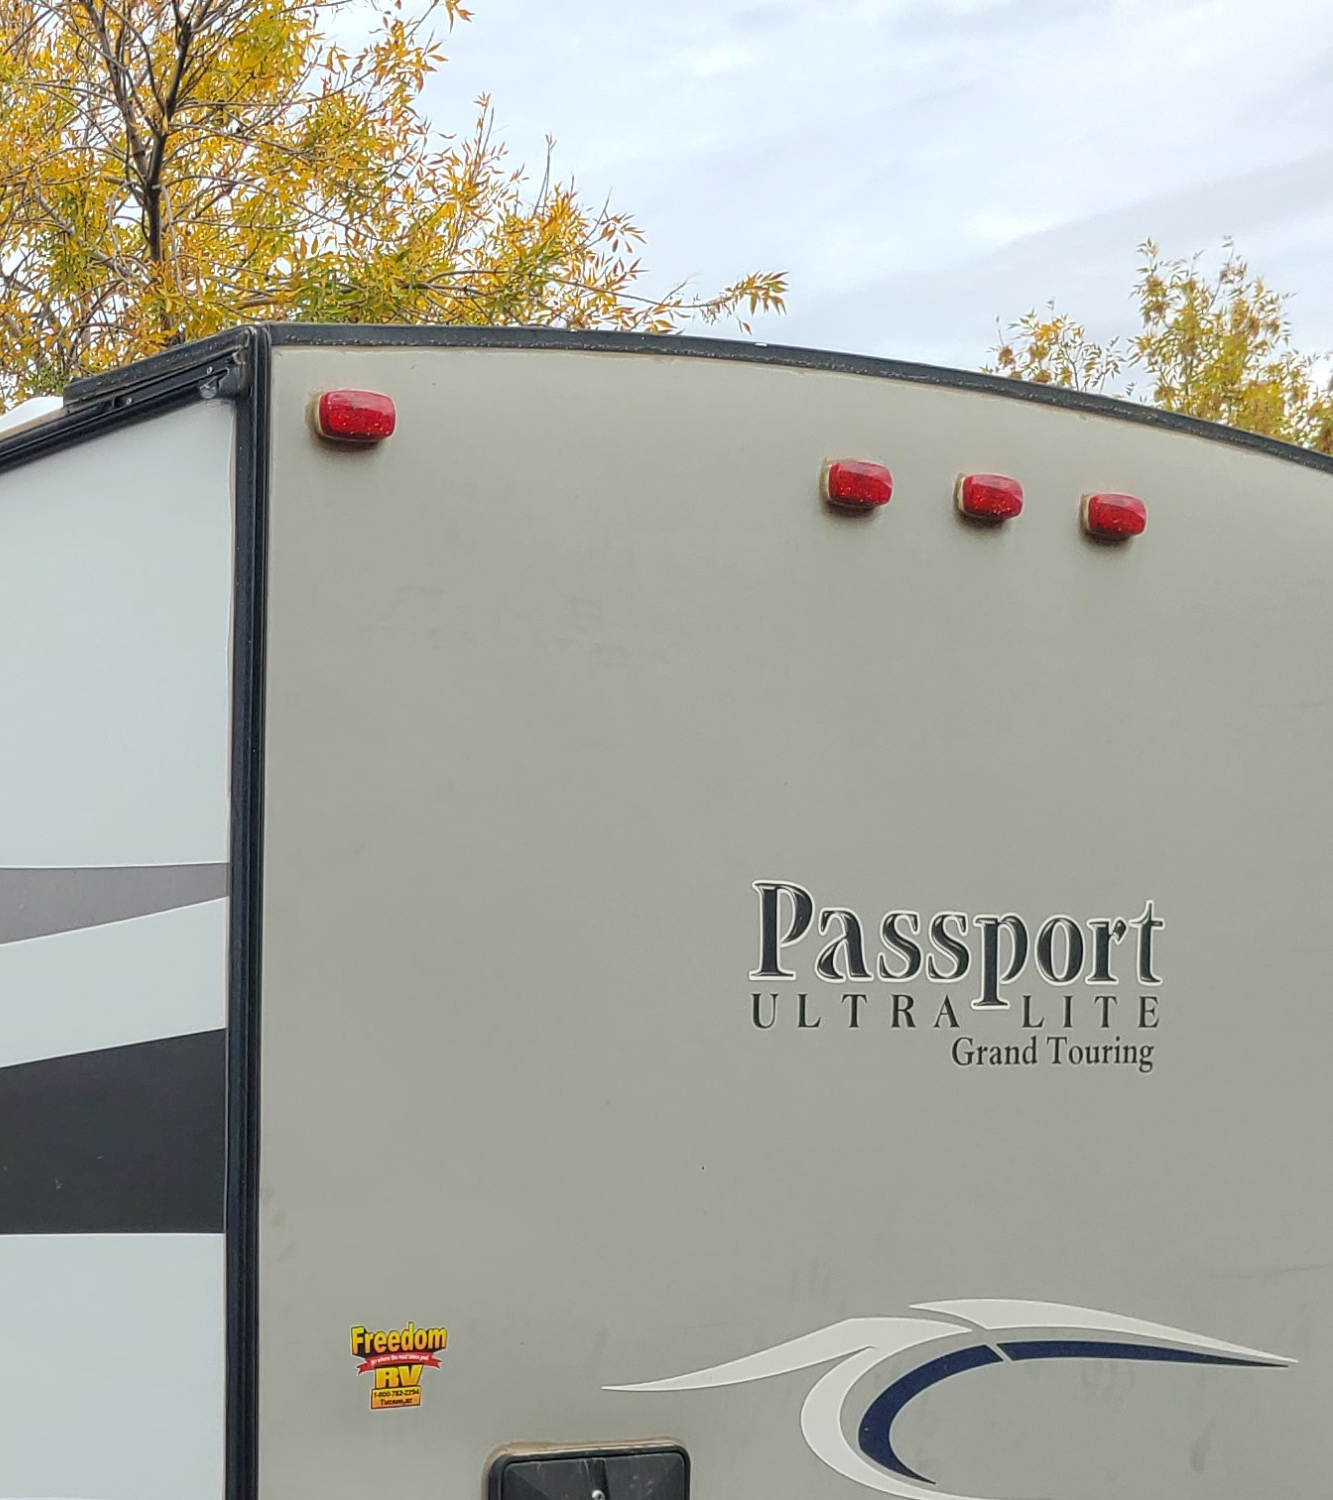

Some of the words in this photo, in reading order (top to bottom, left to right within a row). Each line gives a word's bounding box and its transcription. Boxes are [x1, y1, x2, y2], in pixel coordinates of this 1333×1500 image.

[748, 880, 1164, 1010] Passport
[751, 994, 960, 1028] ULTRA
[1021, 994, 1160, 1028] LITE
[951, 1035, 1038, 1066] Grand
[1046, 1035, 1155, 1073] Touring
[351, 1321, 447, 1355] Freedom
[375, 1364, 423, 1389] RV
